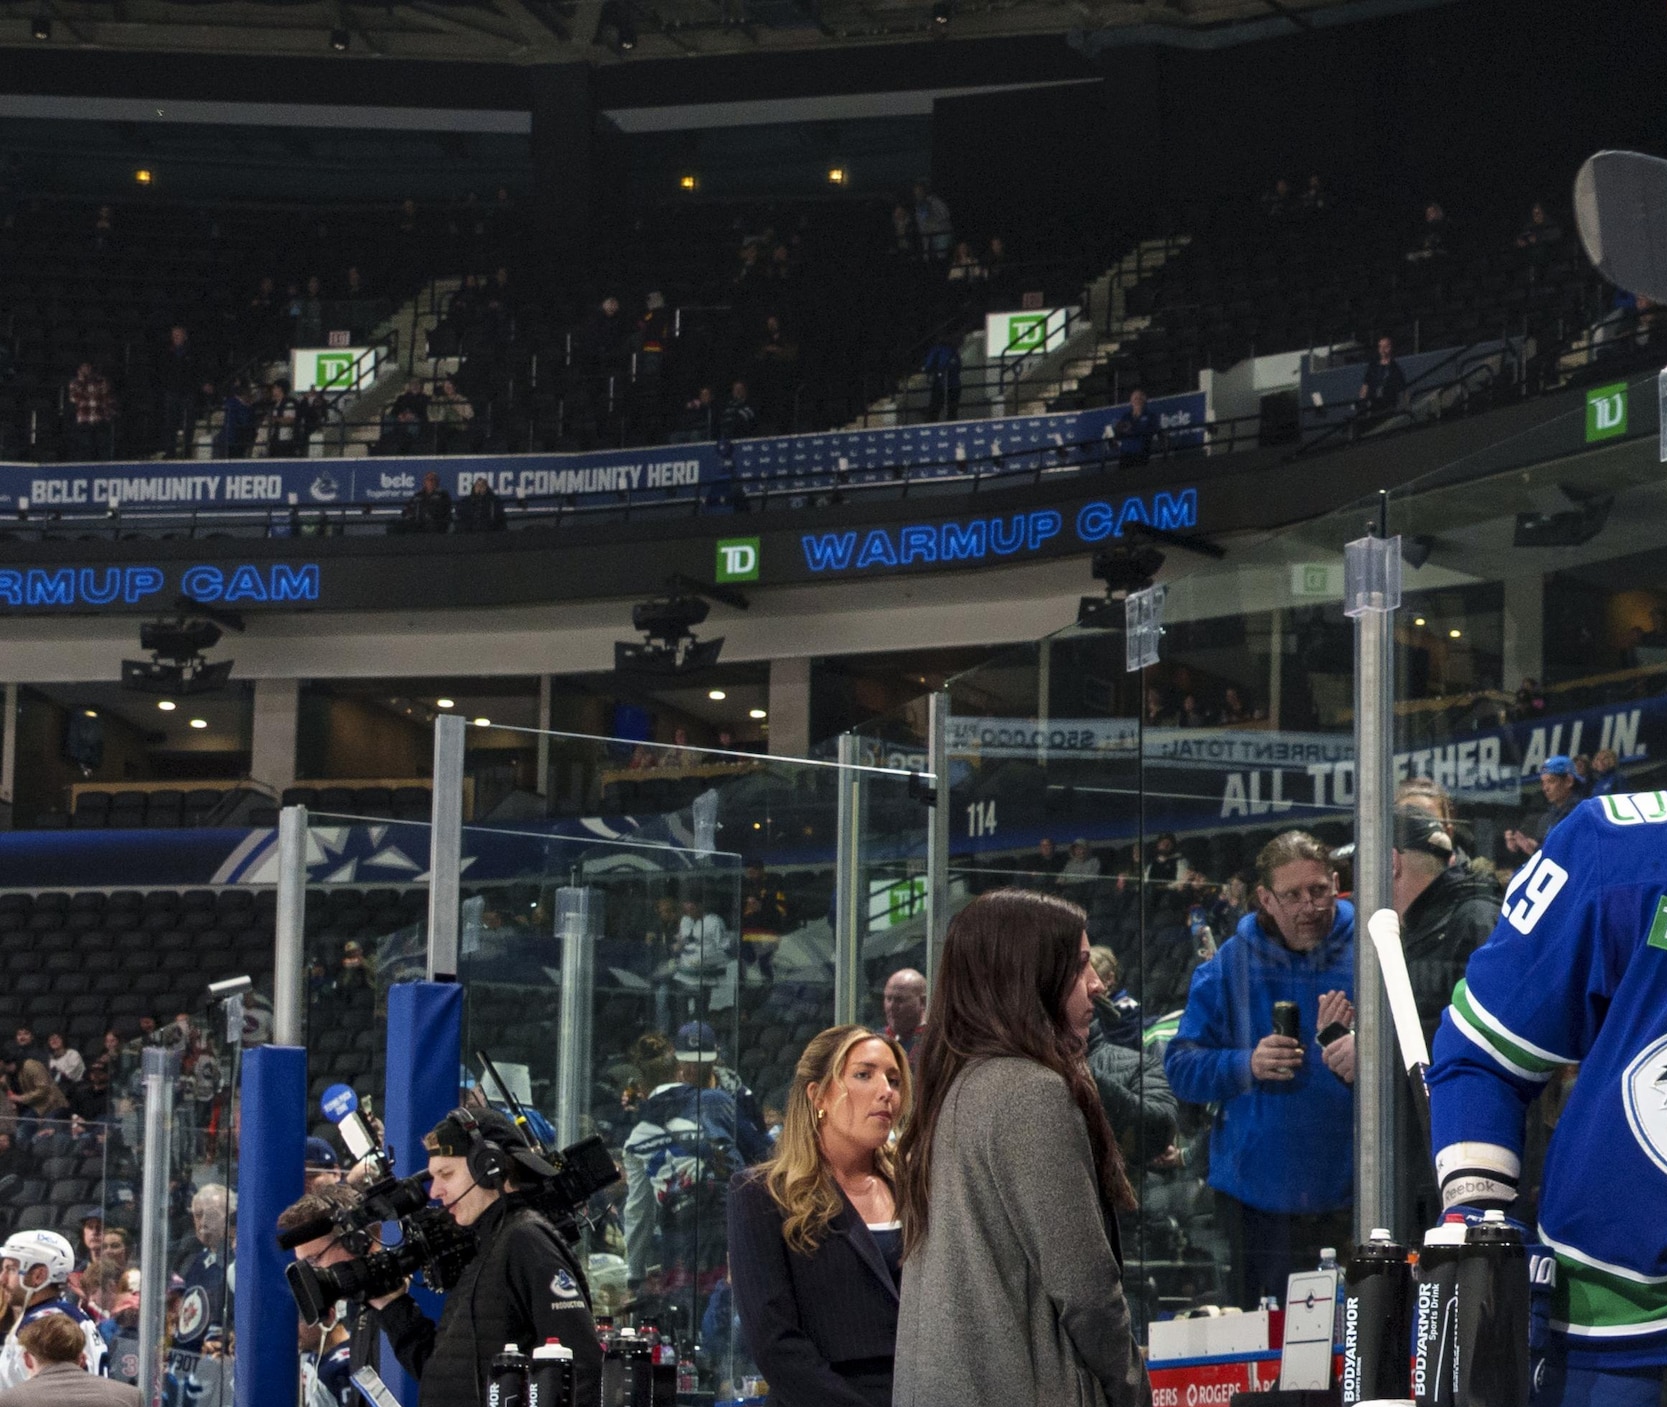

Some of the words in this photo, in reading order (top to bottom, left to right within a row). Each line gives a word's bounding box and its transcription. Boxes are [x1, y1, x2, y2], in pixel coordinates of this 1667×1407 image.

[31, 478, 87, 504] BCLC
[93, 475, 220, 502] COMMUNITY
[225, 474, 283, 500] HERO
[380, 472, 415, 489] bclc
[457, 470, 515, 497] BLC
[518, 464, 641, 497] COMMUNITY
[646, 460, 700, 489] HERO
[802, 509, 1061, 572] WARMUP
[1076, 487, 1198, 542] CAM
[0, 566, 164, 606] RMUP
[181, 563, 320, 602] CAM
[1220, 767, 1293, 819] ALL
[1307, 735, 1512, 808] TOETHER.
[966, 800, 998, 838] 114
[1343, 1296, 1359, 1403] BODYARMOR
[1414, 1281, 1432, 1397] BODYARMOR
[1152, 1385, 1178, 1407] GERS
[1198, 1382, 1241, 1404] ROGERS
